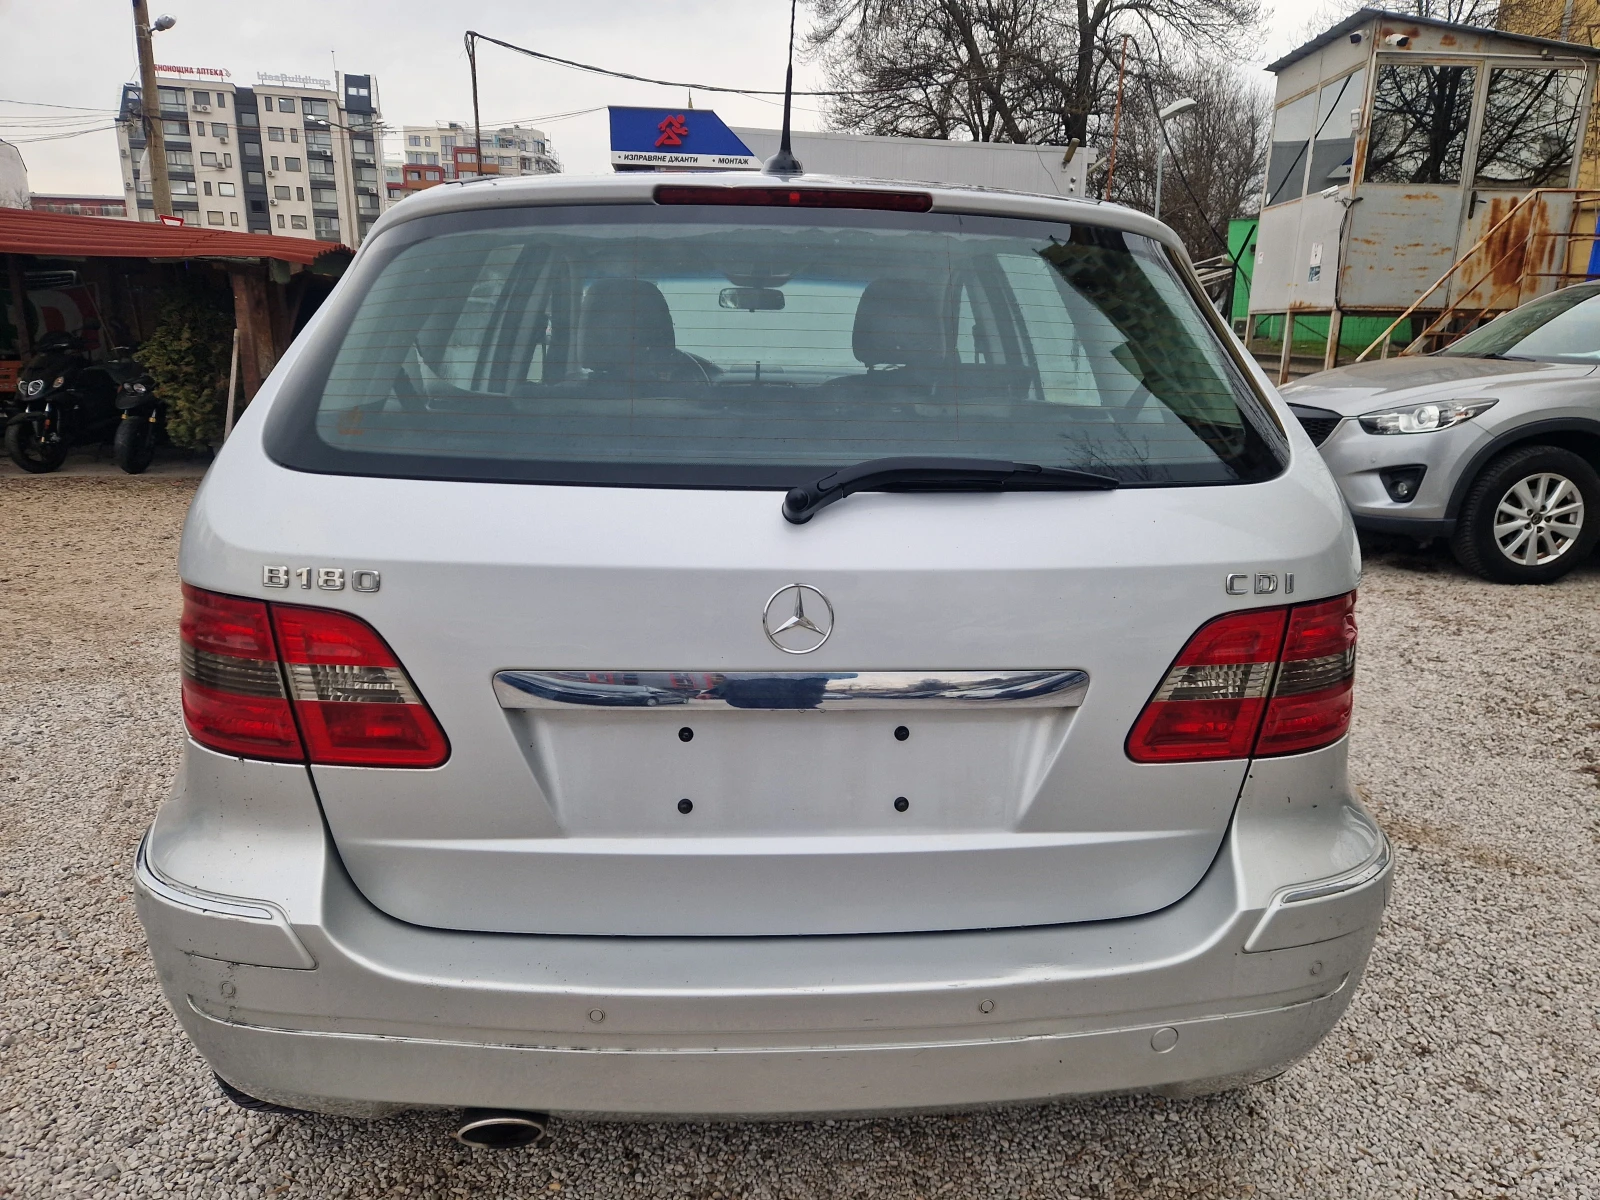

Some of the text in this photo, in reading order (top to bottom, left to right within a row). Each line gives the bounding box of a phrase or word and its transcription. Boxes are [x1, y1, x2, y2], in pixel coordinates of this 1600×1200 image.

[153, 63, 224, 77] ЕНОНОЩНА АПТЕКА
[623, 154, 749, 165] ИЗПРАВЯНЕ ДЖАНТИ МОНТАЖ
[262, 565, 381, 593] B180
[1225, 572, 1295, 596] CDI
